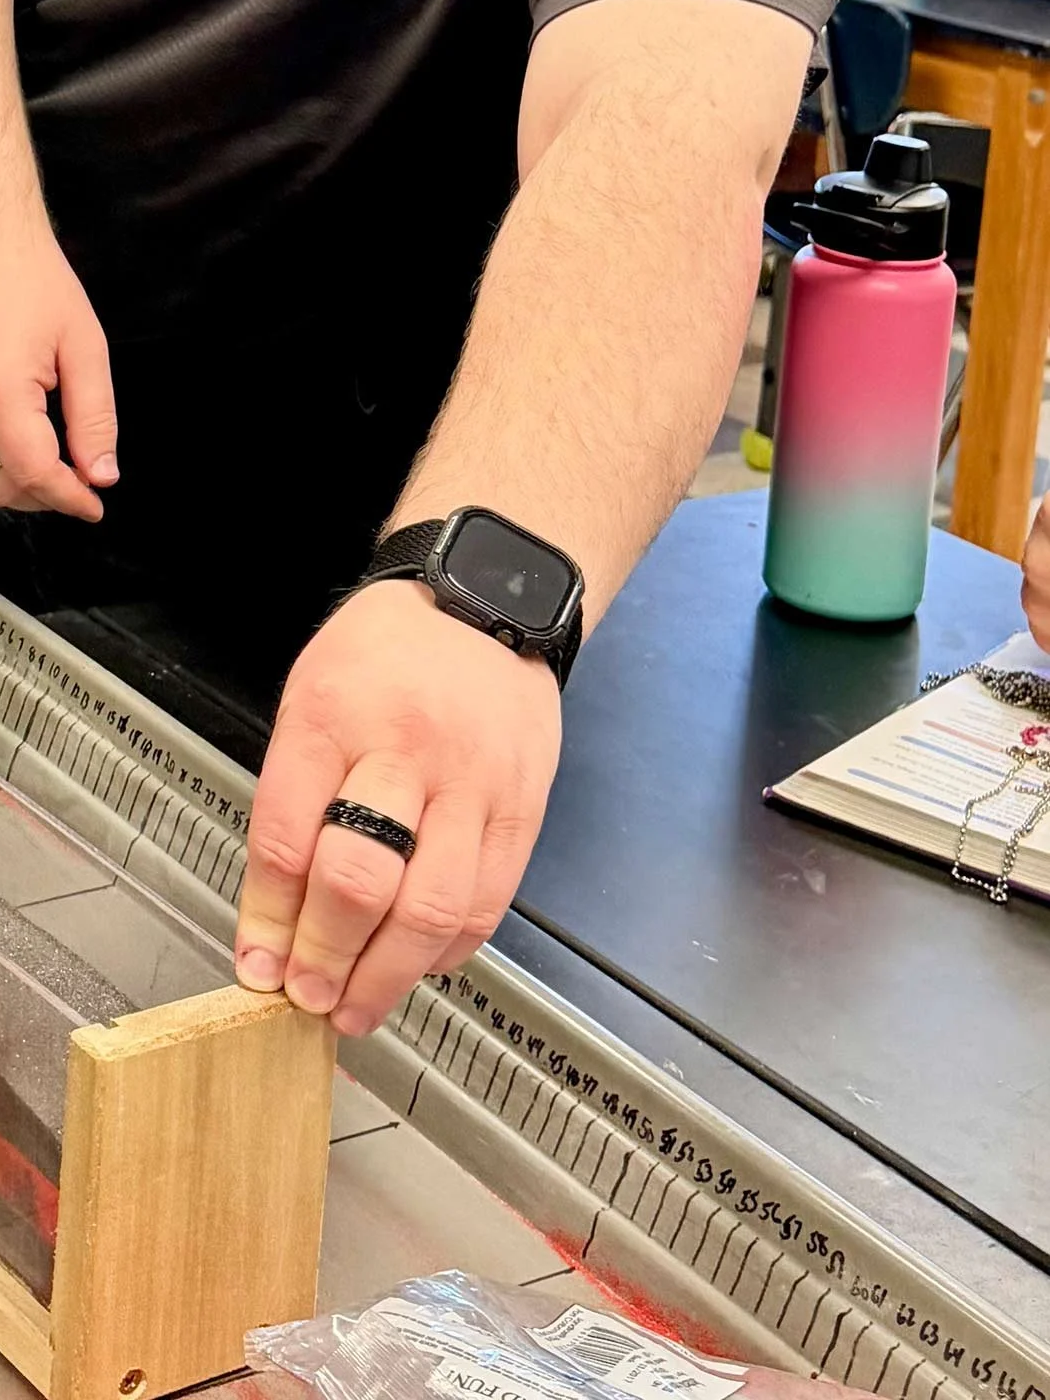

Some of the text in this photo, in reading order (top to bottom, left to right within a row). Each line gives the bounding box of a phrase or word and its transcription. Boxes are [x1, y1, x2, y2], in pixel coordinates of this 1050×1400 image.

[8, 629, 15, 645] 6
[18, 637, 25, 652] 7
[29, 646, 36, 663] 8
[39, 653, 47, 671] 9
[49, 662, 61, 679] 10
[60, 673, 70, 691] 11
[70, 682, 81, 699] 12
[93, 699, 105, 715] 14
[107, 710, 117, 725] 15
[140, 738, 153, 758] 18
[152, 748, 163, 765] 19
[473, 991, 489, 1012] 41
[491, 1007, 506, 1029] 42
[508, 1021, 524, 1044] 43
[527, 1035, 545, 1058] 44
[549, 1050, 567, 1075] 45
[582, 1073, 599, 1096] 47
[621, 1104, 640, 1130] 49
[637, 1116, 654, 1143] 50
[673, 1140, 695, 1162] 52
[693, 1158, 713, 1183] 53
[734, 1189, 760, 1213] 55
[758, 1201, 782, 1224] 56
[779, 1214, 803, 1240] 57
[806, 1230, 829, 1256] 58
[851, 1275, 869, 1300] 60
[871, 1284, 888, 1307] 61
[896, 1303, 916, 1327] 62
[919, 1320, 939, 1346] 63
[943, 1338, 965, 1368] 64
[971, 1357, 996, 1383] 65
[446, 1369, 501, 1398] FUN!
